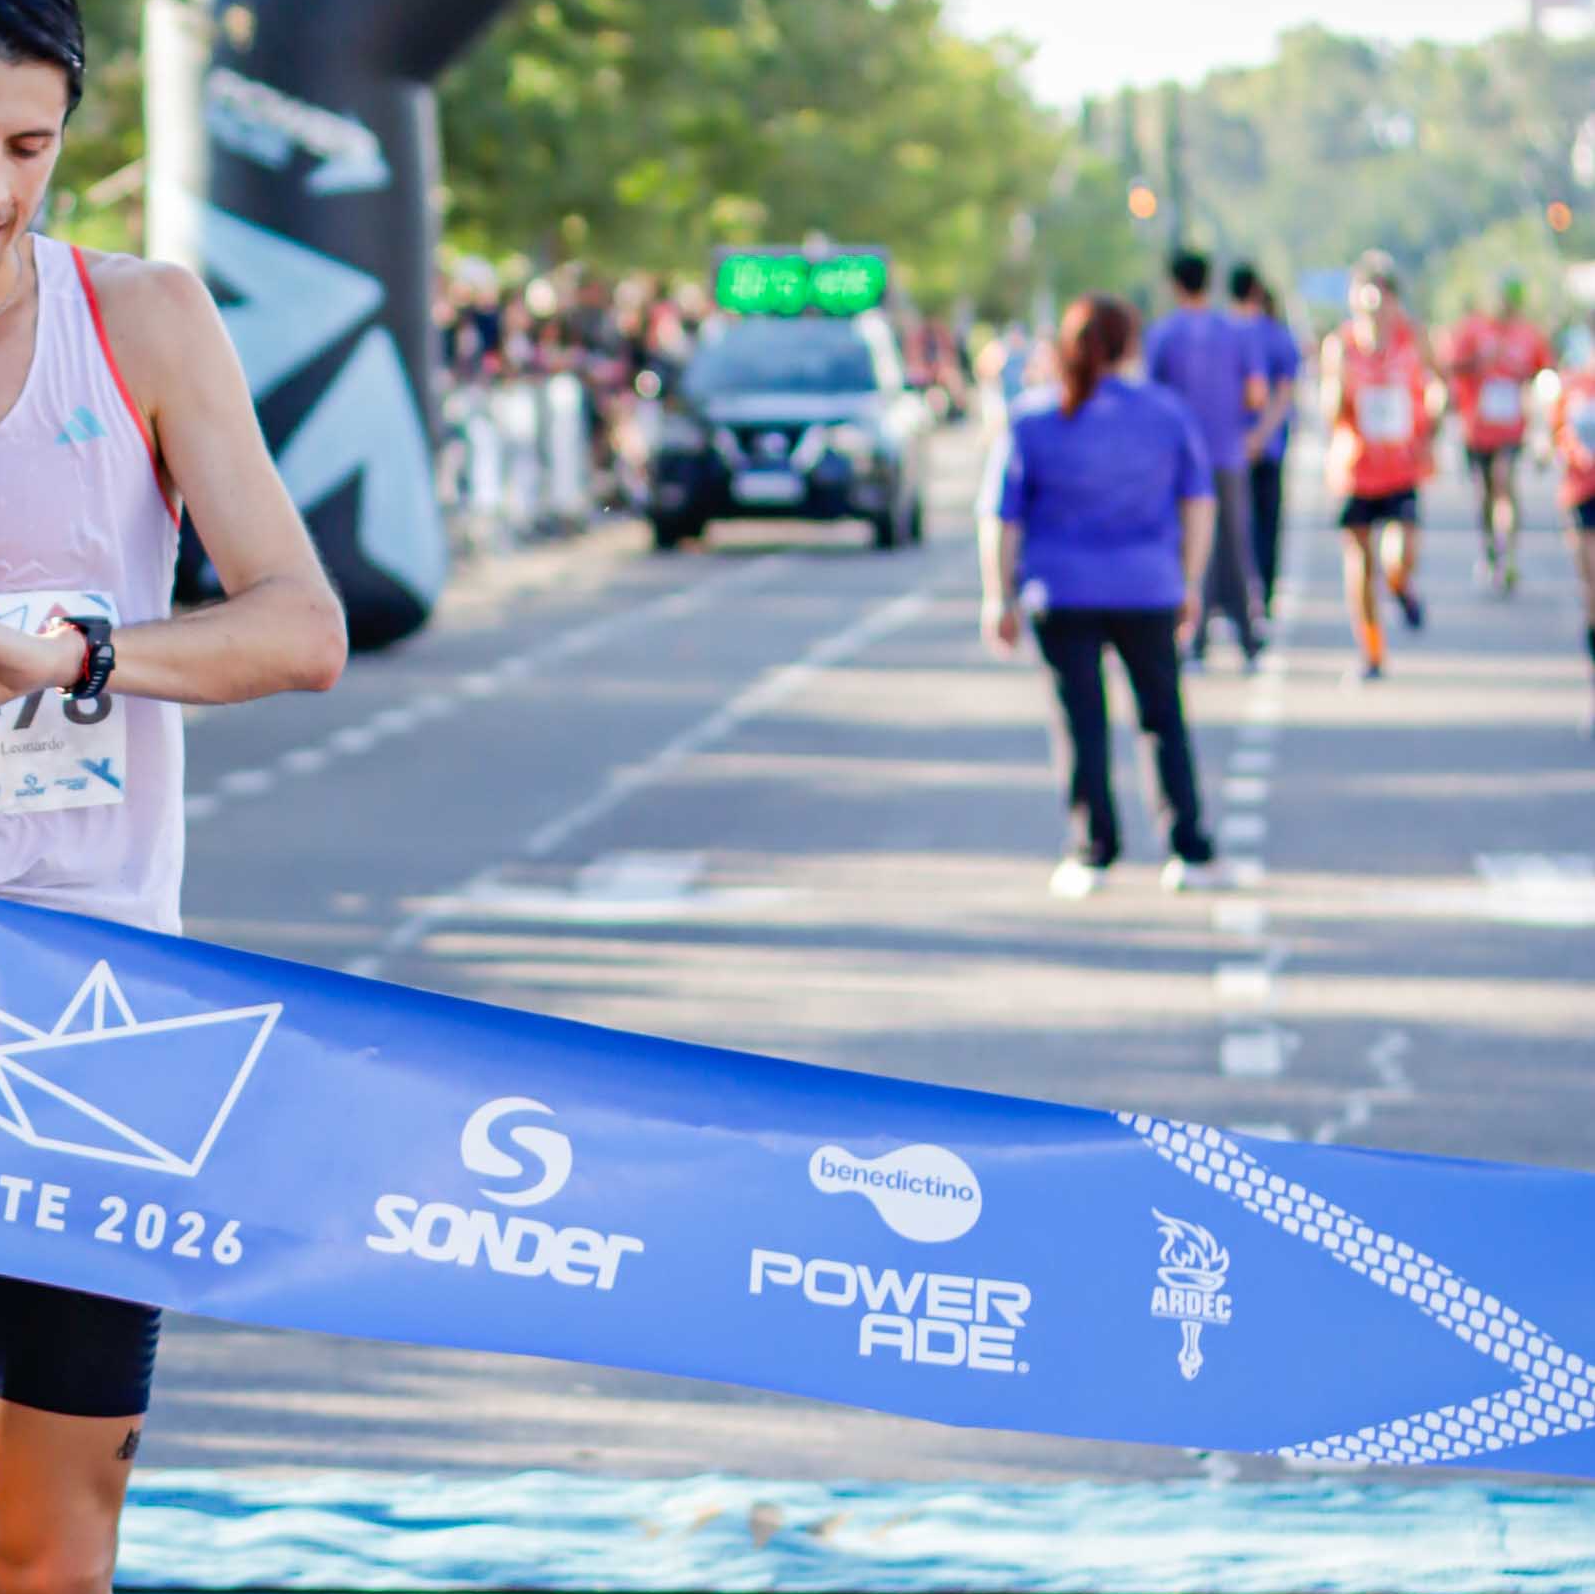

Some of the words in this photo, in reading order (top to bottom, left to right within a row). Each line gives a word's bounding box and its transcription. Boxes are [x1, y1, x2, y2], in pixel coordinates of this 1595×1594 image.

[819, 1156, 974, 1202] benedictino
[93, 1195, 244, 1266] 2026
[749, 1248, 1032, 1328] POWER
[1150, 1285, 1233, 1321] ARDEC
